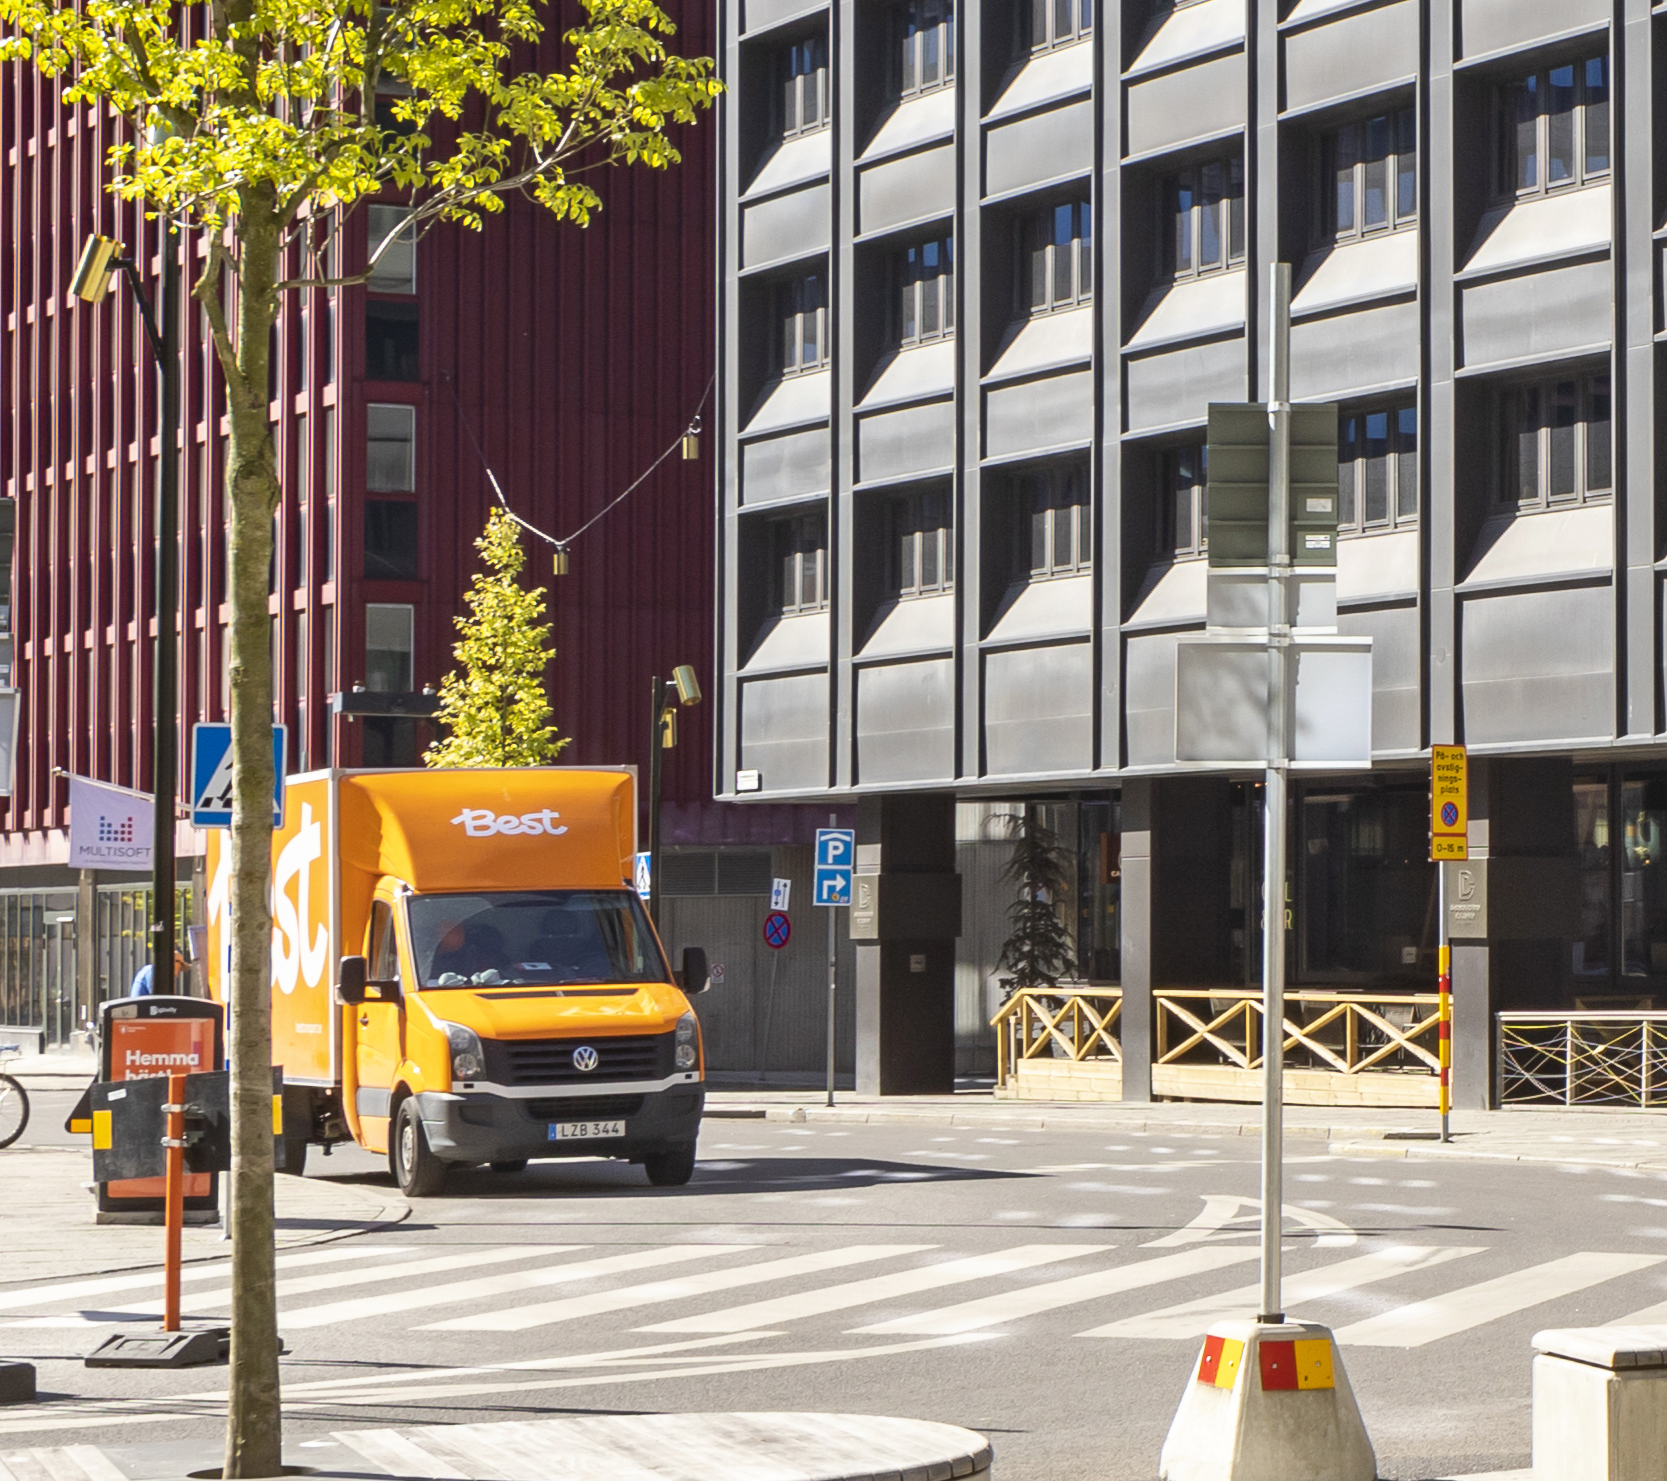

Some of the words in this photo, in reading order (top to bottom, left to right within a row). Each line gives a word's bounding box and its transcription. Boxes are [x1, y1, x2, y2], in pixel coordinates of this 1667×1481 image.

[1435, 750, 1449, 760] På-
[1450, 752, 1464, 761] och
[1436, 763, 1464, 774] avstig-
[1437, 774, 1462, 785] nings-
[1440, 785, 1460, 796] plats
[450, 808, 569, 838] Best
[79, 845, 152, 858] MULTISOFT
[125, 1049, 200, 1066] Hemma
[561, 1123, 588, 1138] LZB
[592, 1122, 620, 1136] 344
